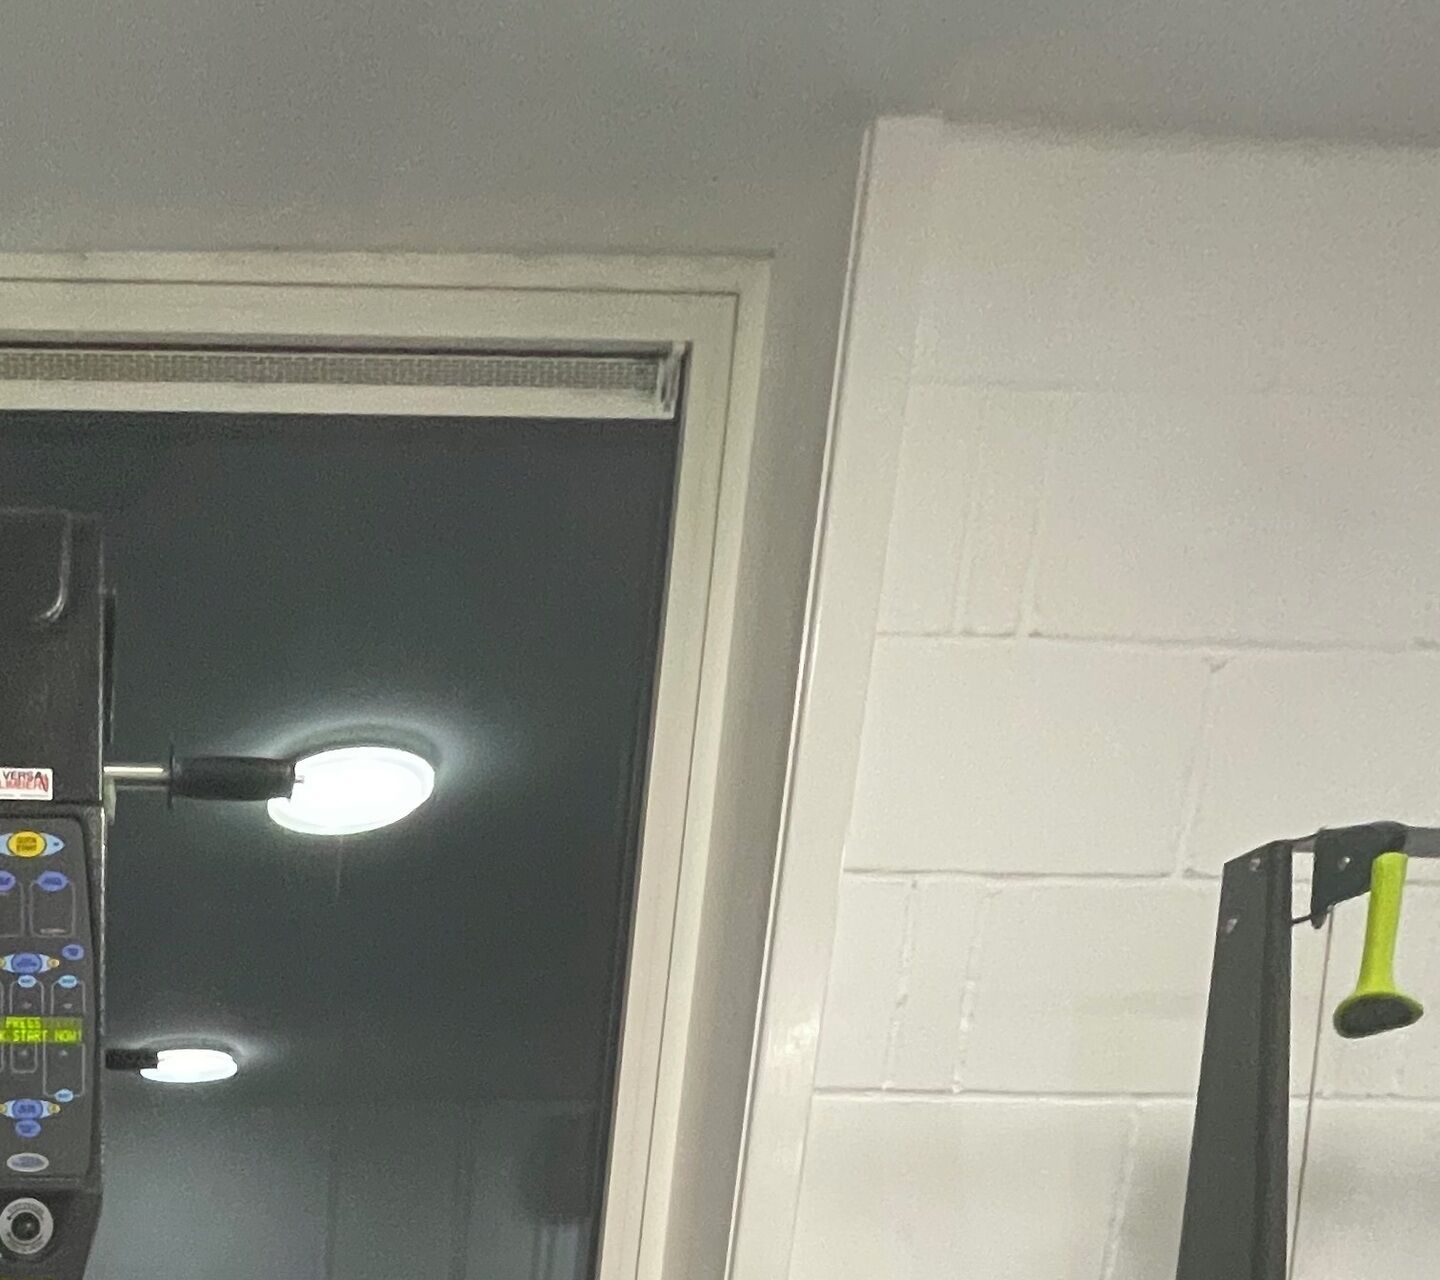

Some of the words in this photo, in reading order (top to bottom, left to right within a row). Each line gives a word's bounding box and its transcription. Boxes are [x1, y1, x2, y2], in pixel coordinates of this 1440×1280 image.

[2, 770, 42, 780] VERSA
[5, 1016, 40, 1028] PRESS
[13, 1029, 48, 1041] START
[55, 1029, 82, 1041] NOW!
